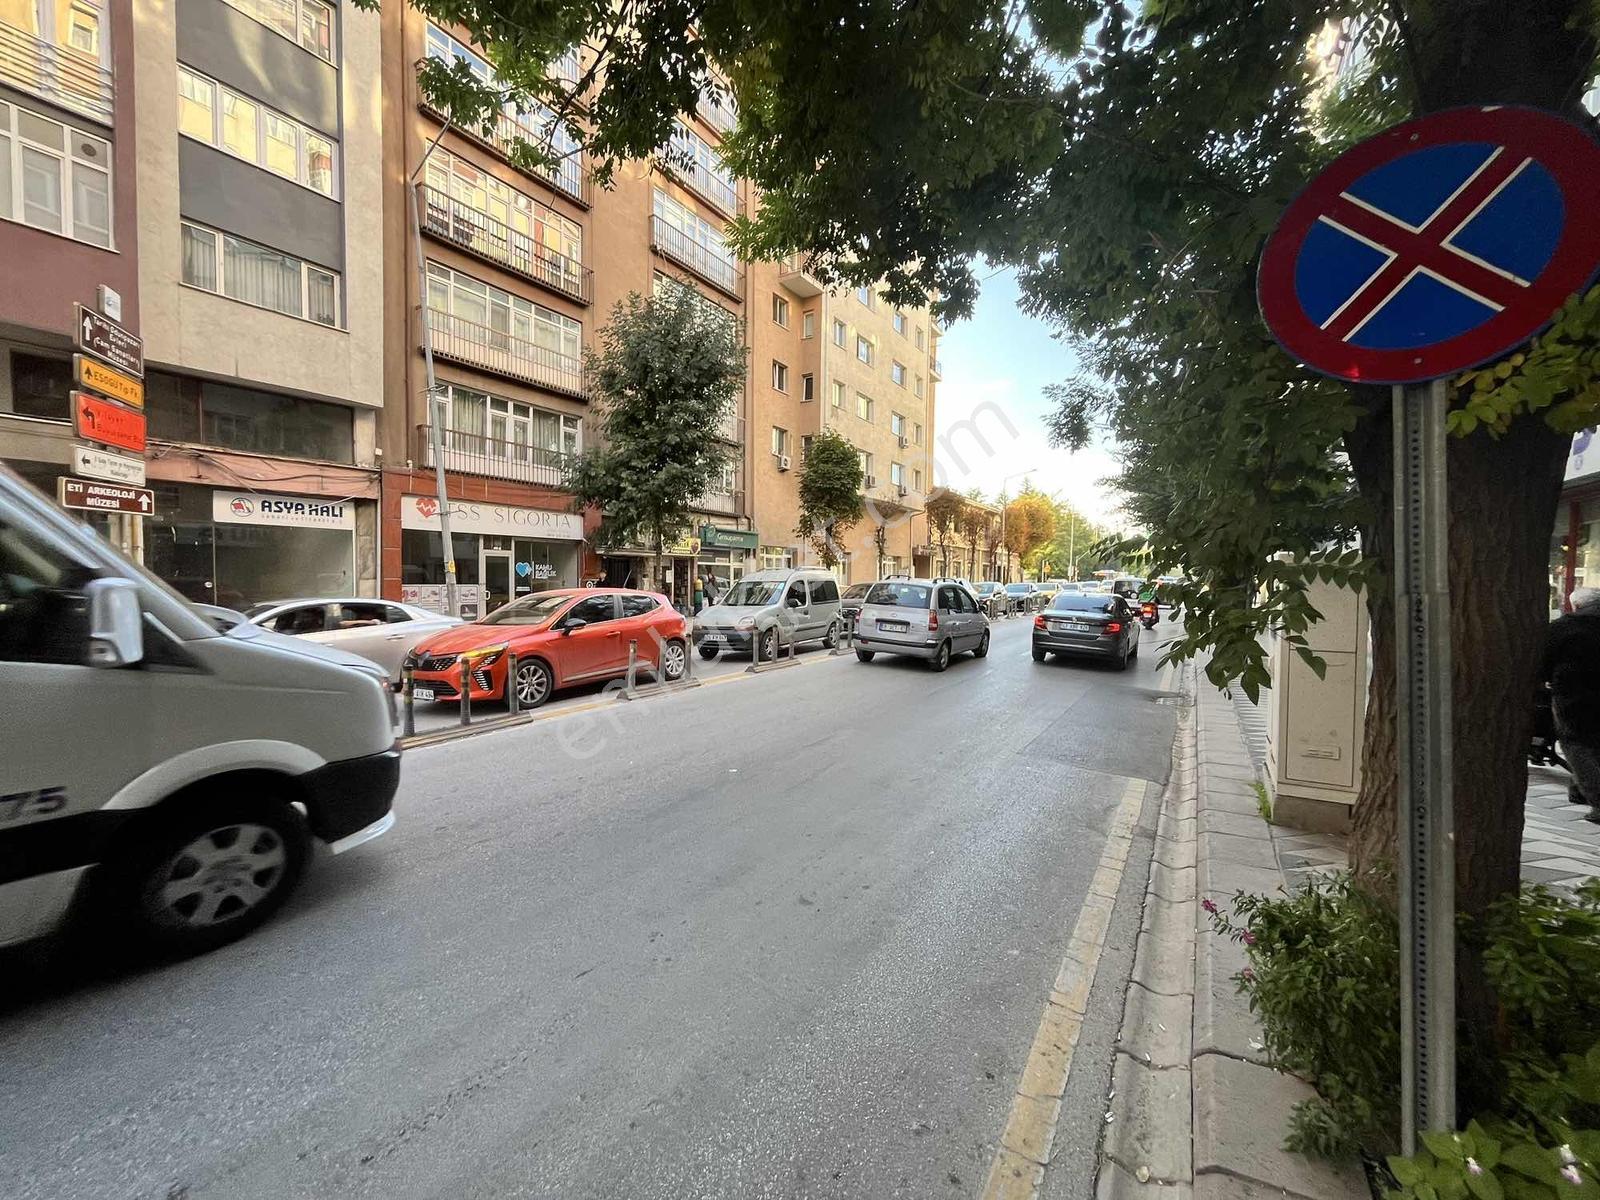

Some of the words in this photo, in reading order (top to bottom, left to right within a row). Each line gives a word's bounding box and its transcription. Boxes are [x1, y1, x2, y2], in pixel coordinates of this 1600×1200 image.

[67, 483, 83, 493] ETİ
[88, 486, 136, 499] ARKEOLOJİ
[86, 497, 120, 508] MÜZESİ
[261, 500, 305, 515] ASYA
[309, 503, 343, 518] HALI
